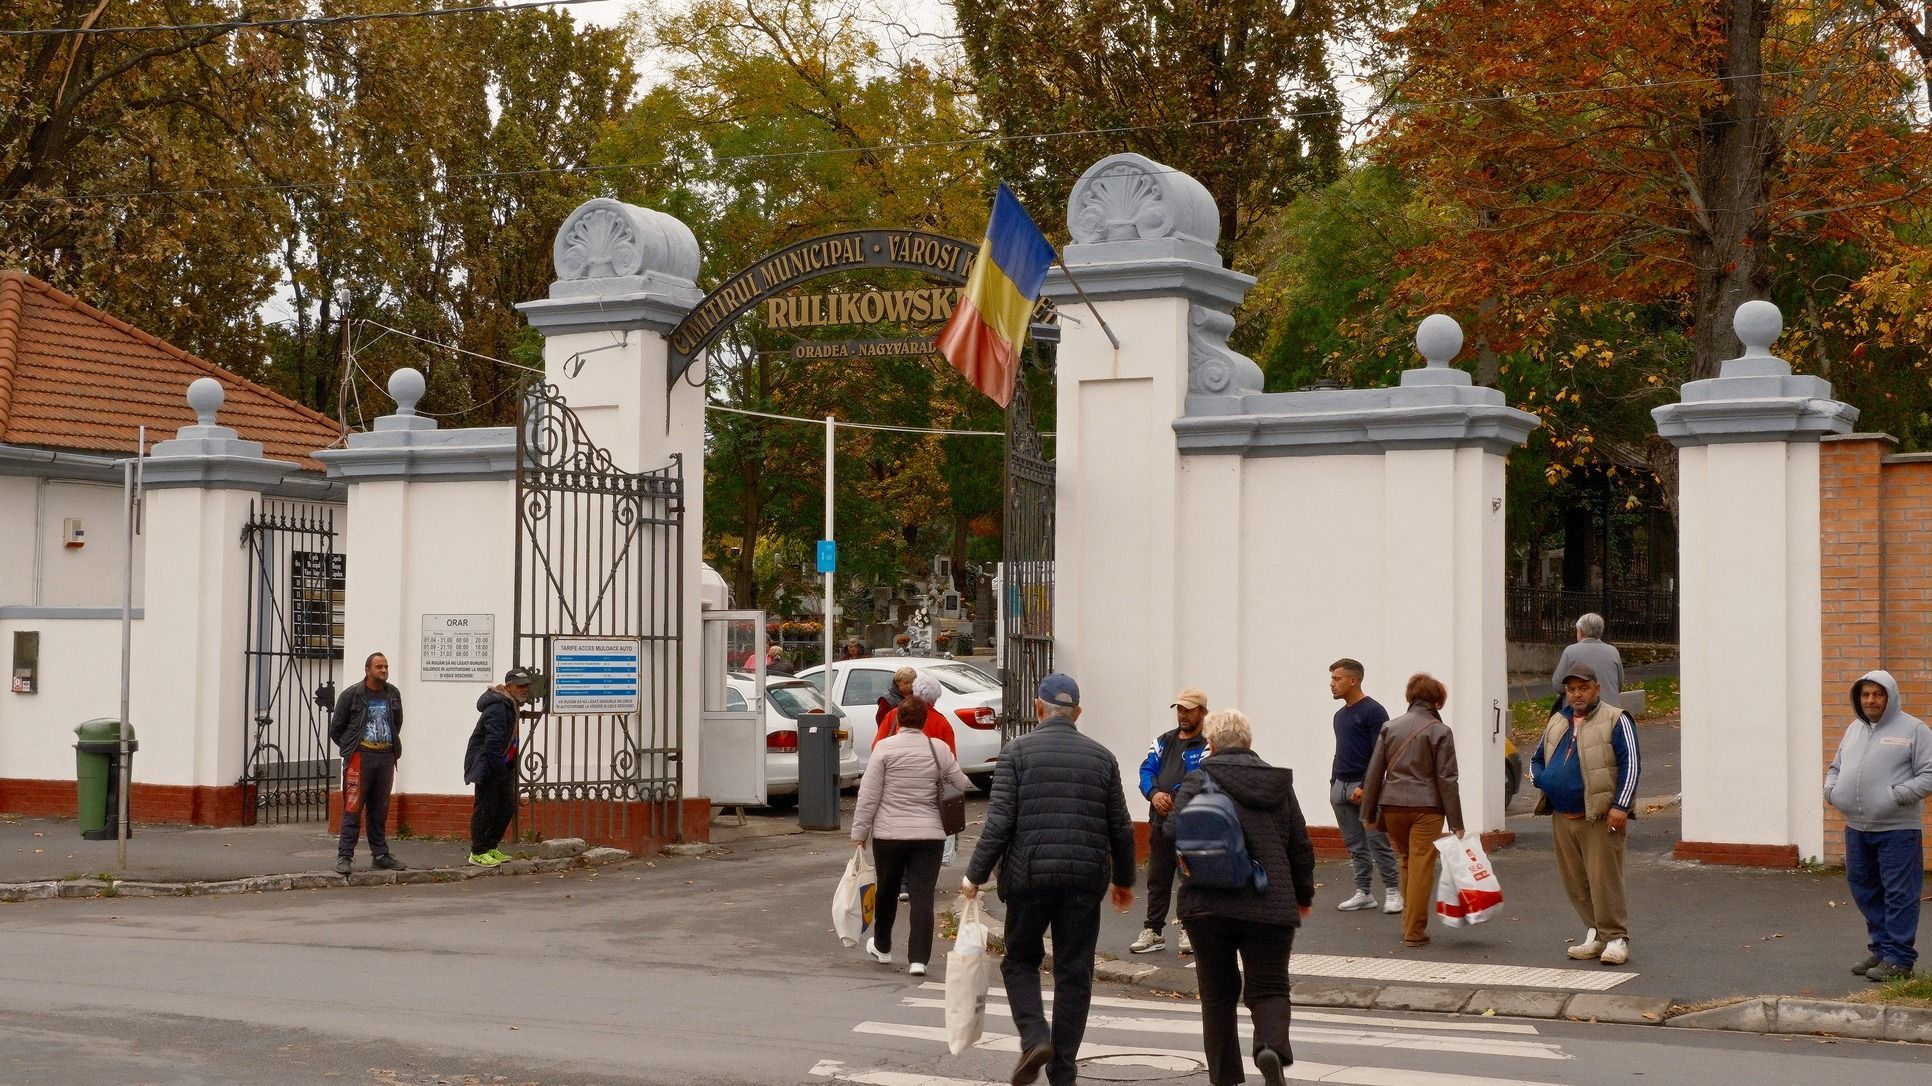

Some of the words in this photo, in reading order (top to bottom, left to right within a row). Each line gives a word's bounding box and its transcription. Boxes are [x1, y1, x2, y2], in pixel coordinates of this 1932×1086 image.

[672, 272, 763, 356] CIMITIRUL
[760, 236, 865, 290] MUNICIPAL
[887, 232, 961, 272] VÁROSI
[796, 344, 849, 358] ORADEA
[446, 618, 469, 627] ORAR
